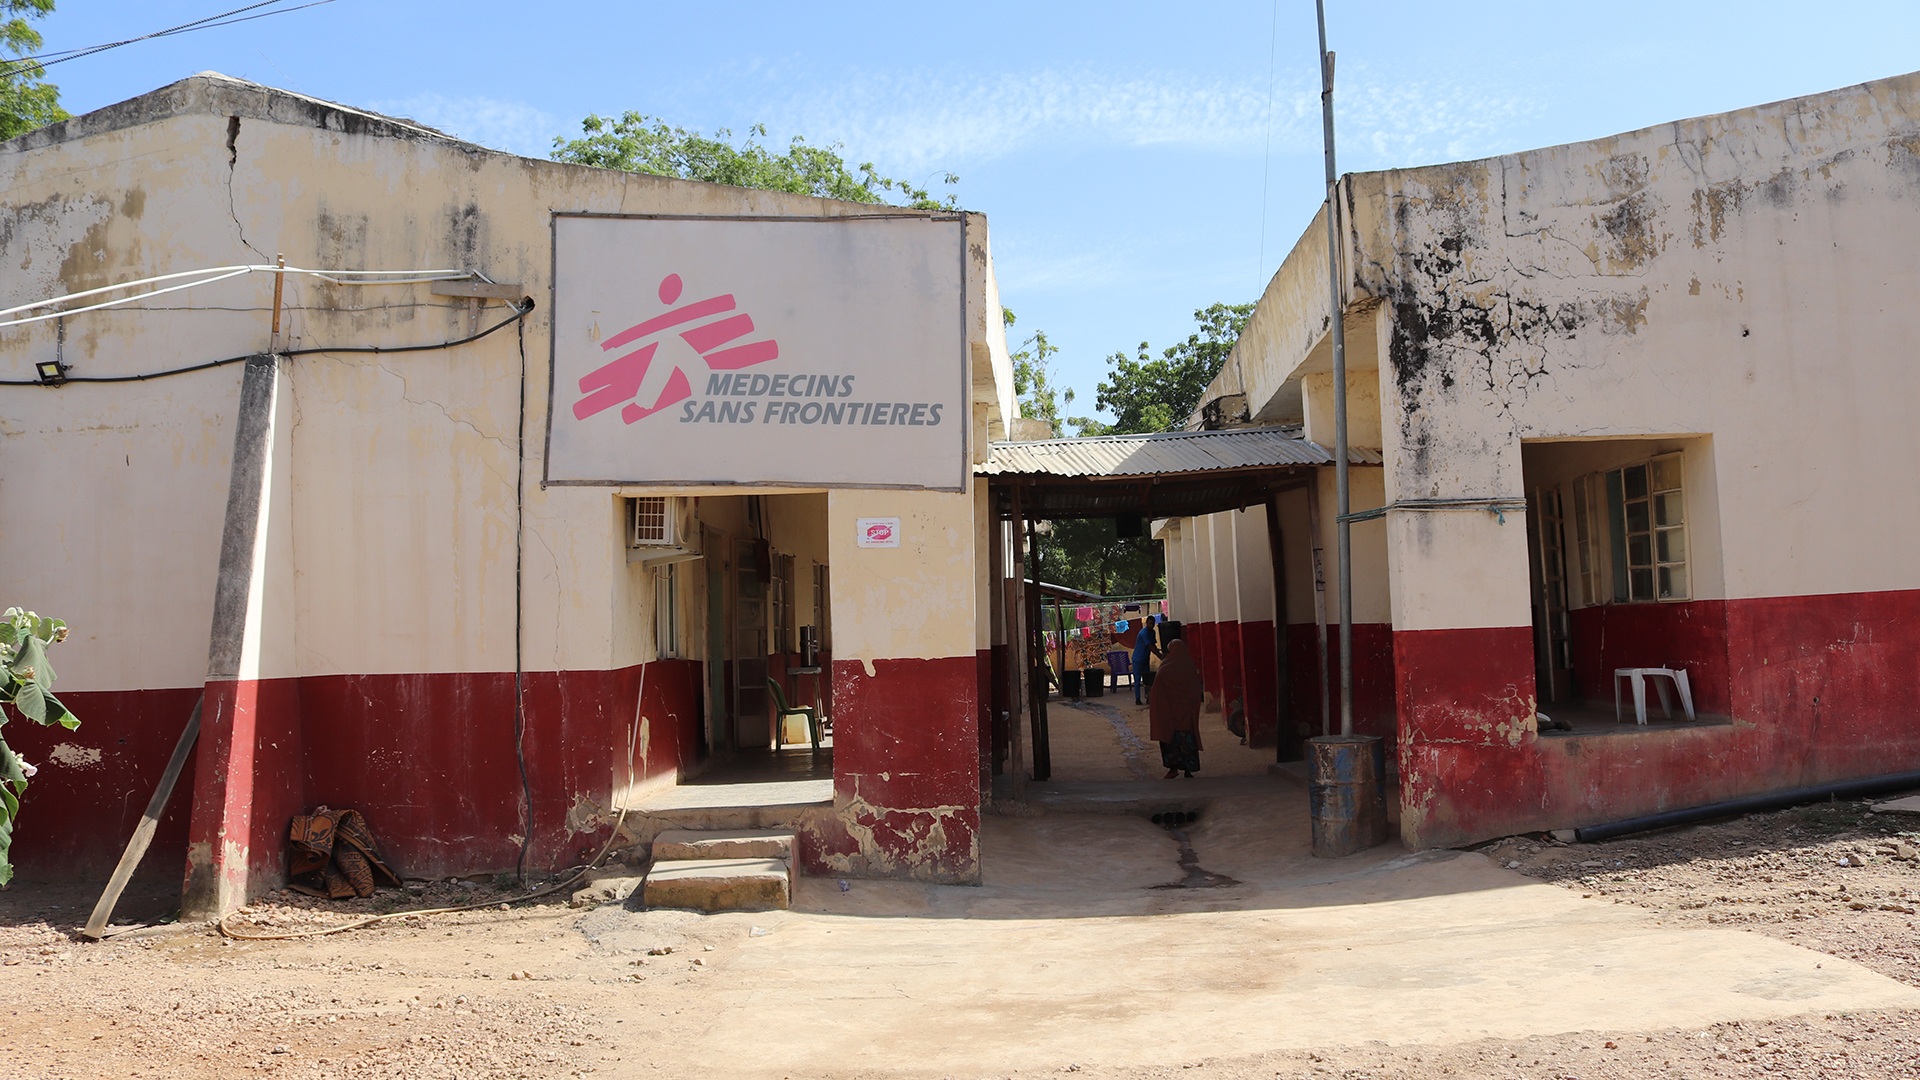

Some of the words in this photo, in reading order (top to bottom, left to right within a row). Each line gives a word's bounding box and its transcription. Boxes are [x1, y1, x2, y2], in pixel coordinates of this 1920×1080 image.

[705, 373, 855, 397] MEDECINS
[679, 401, 757, 424] SANS
[763, 402, 944, 426] FRONTIERES
